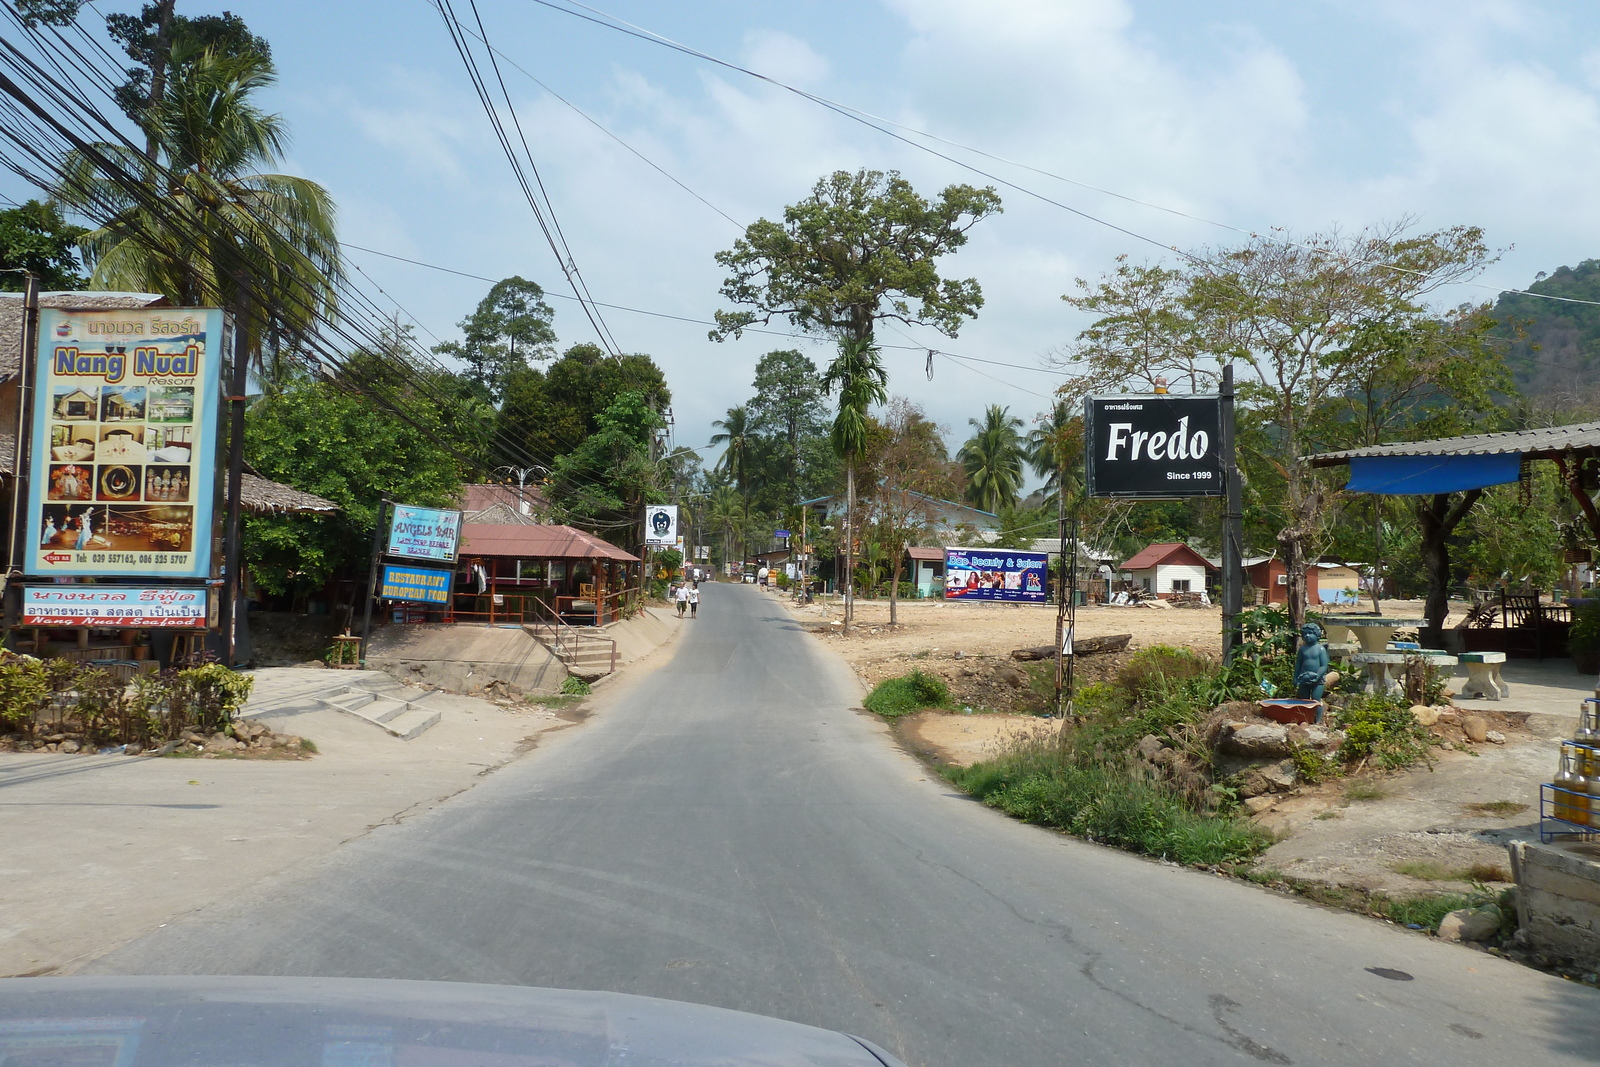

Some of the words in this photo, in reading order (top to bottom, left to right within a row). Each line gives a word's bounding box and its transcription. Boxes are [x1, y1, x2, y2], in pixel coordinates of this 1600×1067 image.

[88, 320, 145, 335] นางนวล
[150, 316, 201, 336] รีสอร์ท
[54, 346, 126, 384] Nang
[134, 345, 198, 377] Nual
[148, 377, 196, 385] Resort
[1105, 415, 1209, 461] Fredo
[1166, 472, 1190, 480] Since
[1192, 472, 1212, 480] 1999
[394, 522, 433, 537] ANGELS
[436, 525, 455, 541] BAR
[429, 540, 450, 549] BEFORE
[76, 553, 87, 563] Tel:
[92, 554, 105, 563] 039
[108, 554, 136, 565] 557162,
[139, 554, 152, 564] 086
[155, 555, 168, 564] 525
[170, 555, 188, 564] 5707
[950, 556, 969, 566] Dao
[972, 556, 1004, 569] Beauty
[1006, 558, 1014, 567] &
[1016, 558, 1042, 568] Salon
[388, 572, 445, 587] RESTAURANT
[32, 591, 127, 601] นางนวล
[139, 590, 196, 604] ซีฟู้ด
[382, 585, 426, 600] EUROPEAN
[427, 589, 448, 601] FOOD
[28, 606, 99, 617] อาหารทะเล
[106, 607, 143, 617] สดสด
[150, 605, 202, 617] เป็นเป็น
[30, 616, 74, 626] Nang
[81, 617, 123, 625] Nual
[129, 617, 196, 626] Seafood
